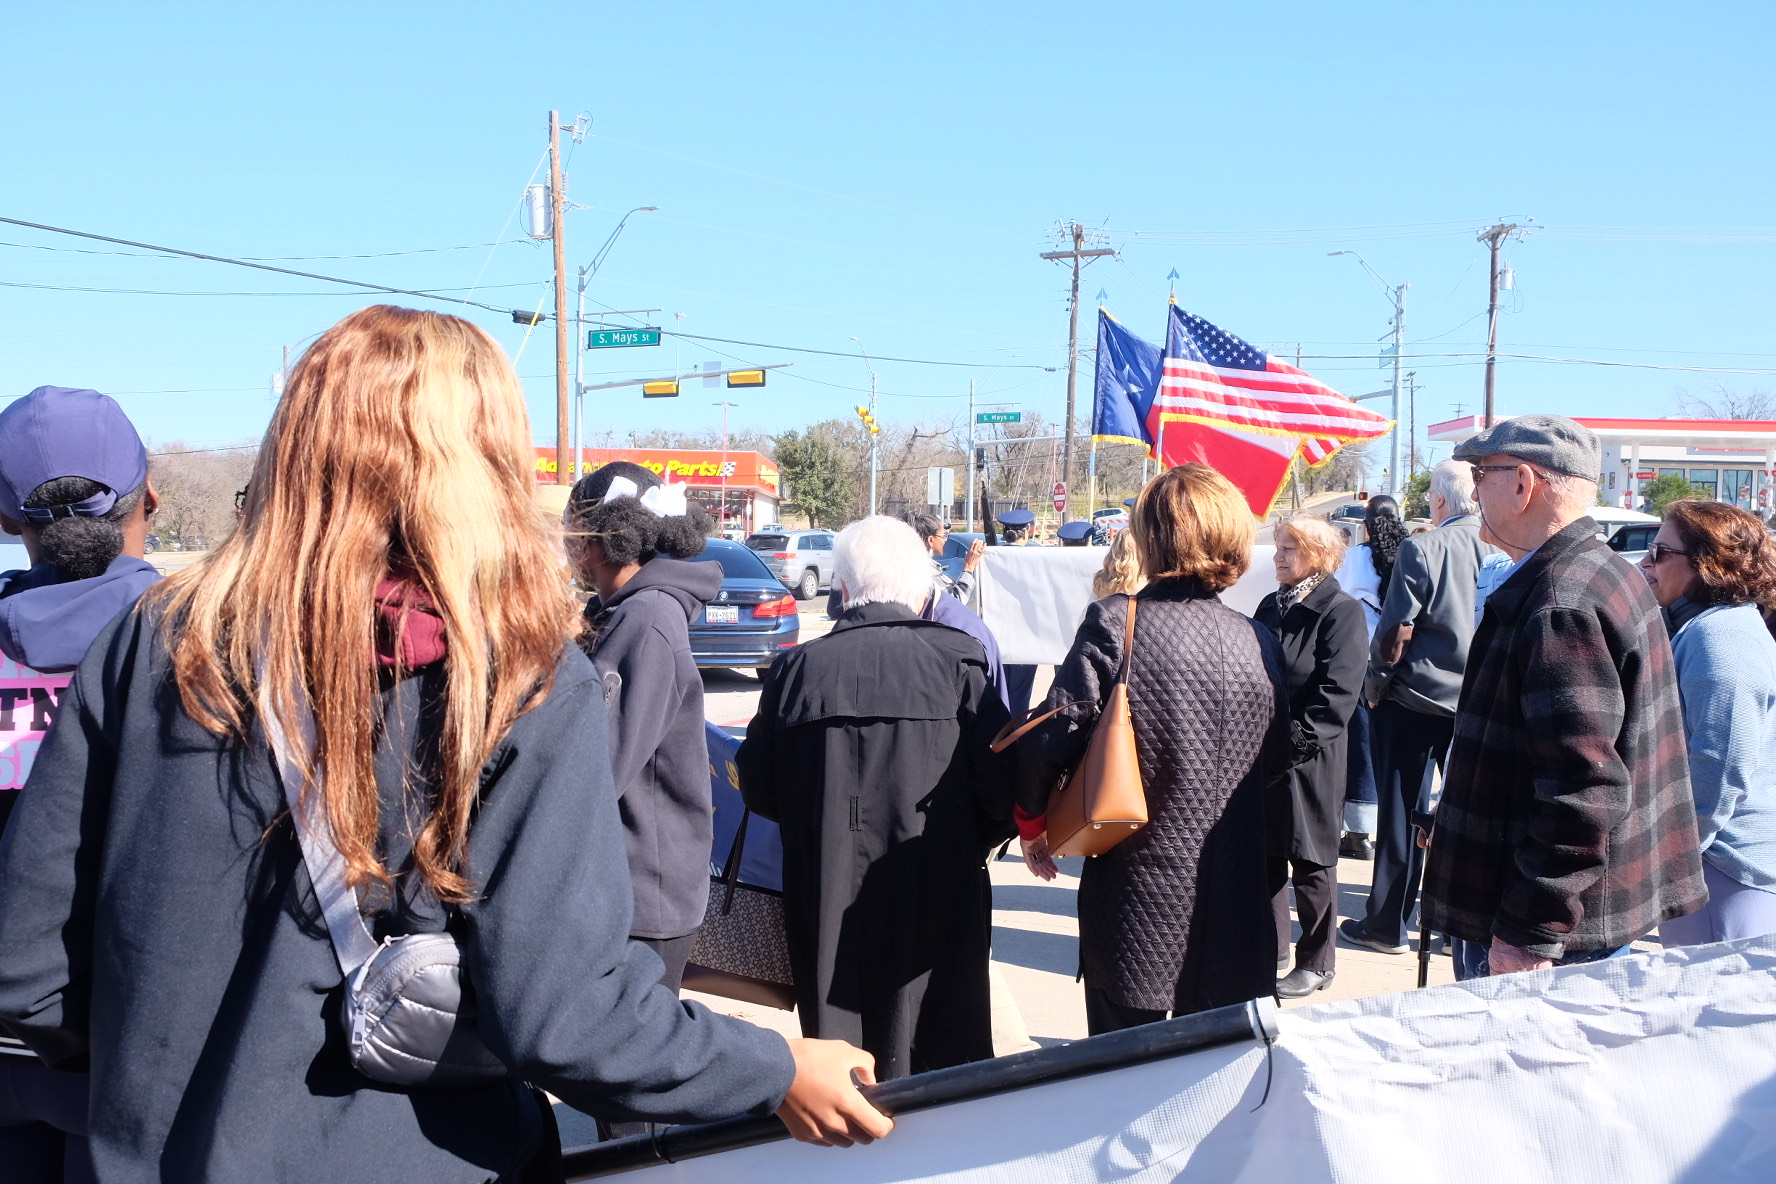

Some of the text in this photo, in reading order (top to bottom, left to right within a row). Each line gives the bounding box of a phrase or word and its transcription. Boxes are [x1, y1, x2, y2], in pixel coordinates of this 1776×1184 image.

[598, 333, 650, 345] S. Mays St
[666, 460, 719, 477] Parts
